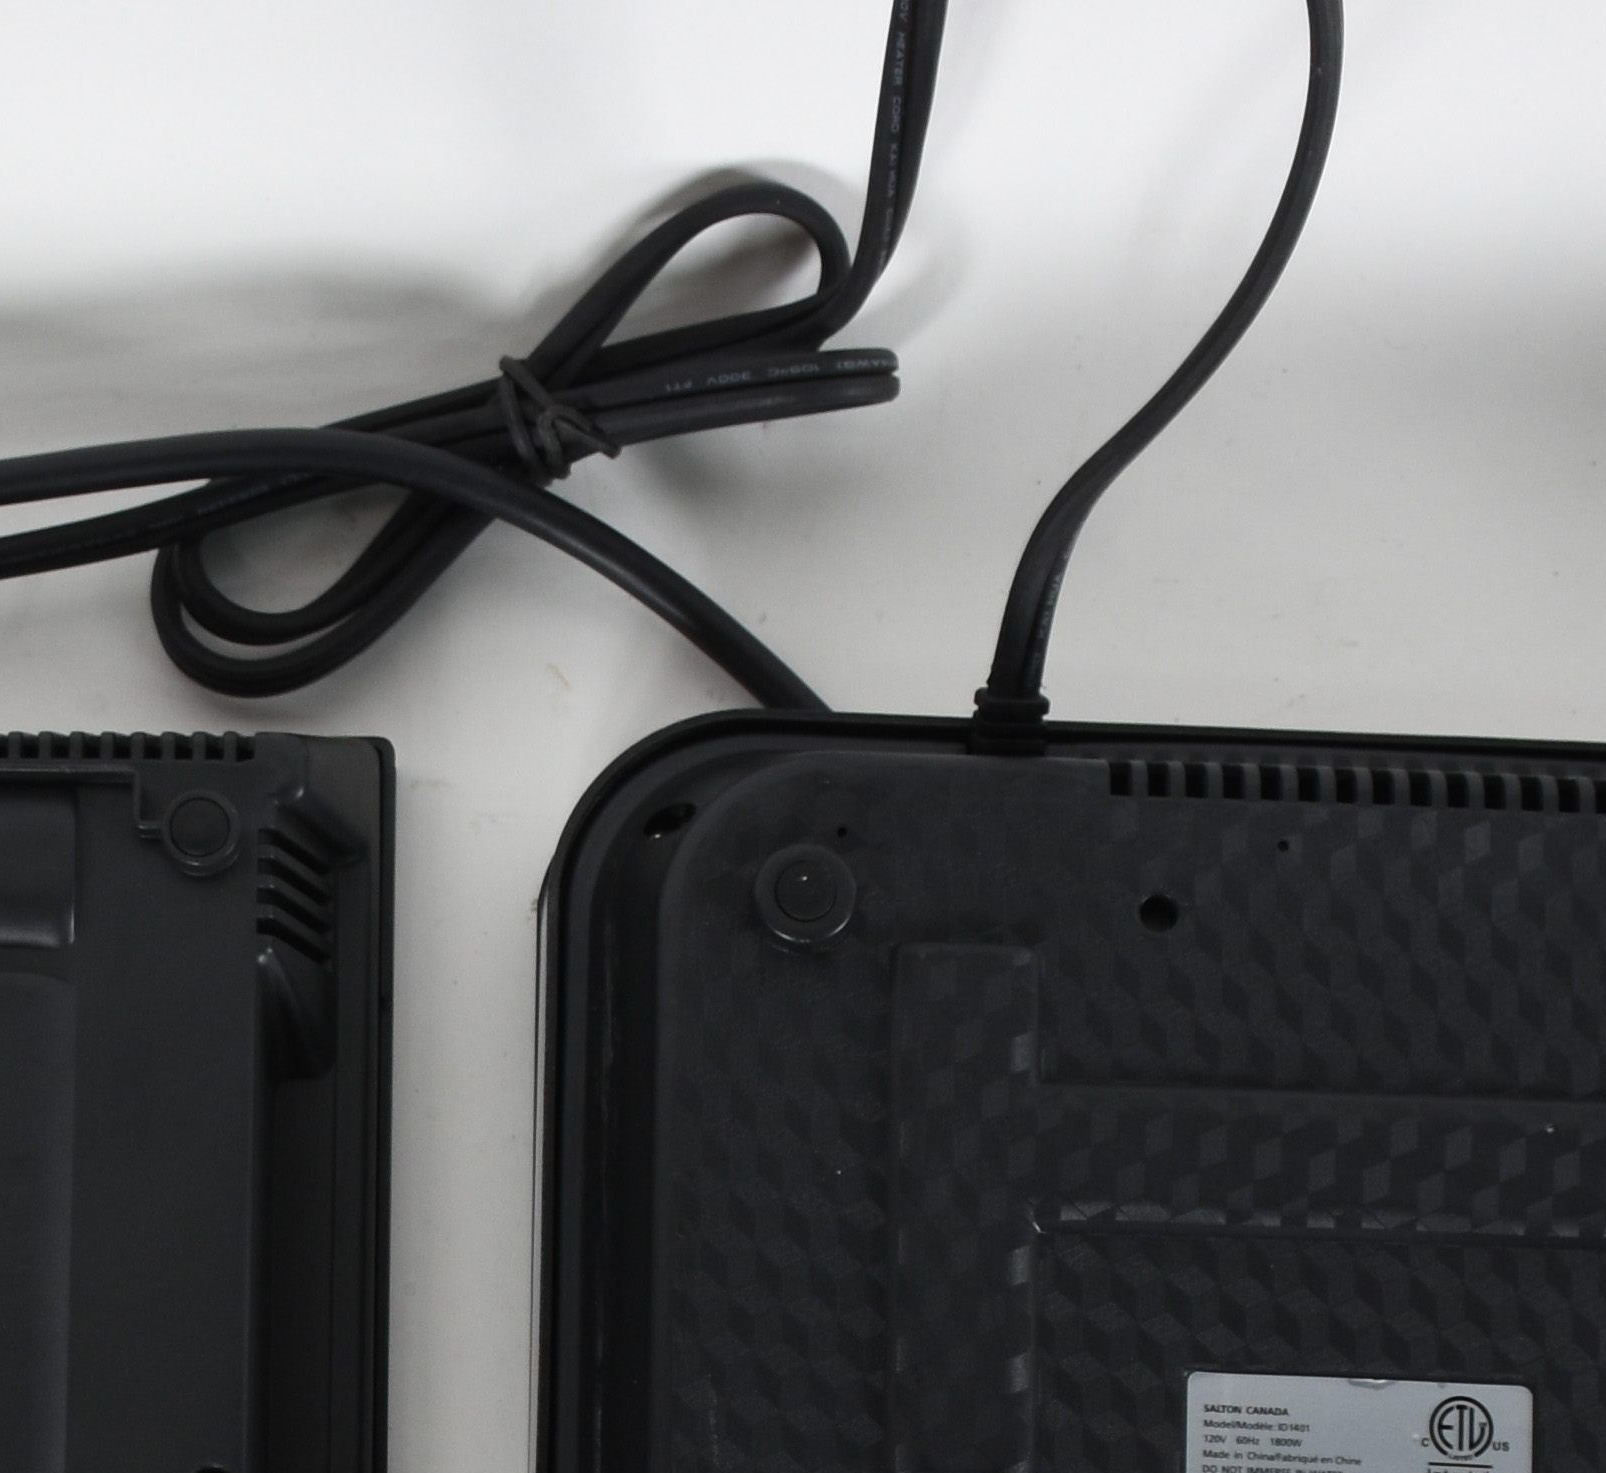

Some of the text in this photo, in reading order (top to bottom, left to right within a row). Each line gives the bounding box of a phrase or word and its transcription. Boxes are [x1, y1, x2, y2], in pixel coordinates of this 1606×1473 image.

[891, 31, 907, 86] HEATER
[889, 96, 903, 134] CORD
[1204, 1403, 1289, 1417] SALTON CANADA
[1277, 1422, 1310, 1433] ID1401
[1204, 1434, 1303, 1448] 120V 60Hz 1800W
[1492, 1441, 1510, 1452] US
[1202, 1449, 1230, 1459] Made
[1234, 1450, 1243, 1460] in
[1320, 1455, 1333, 1465] en
[1335, 1456, 1362, 1466] Chine
[1202, 1464, 1218, 1473] DO
